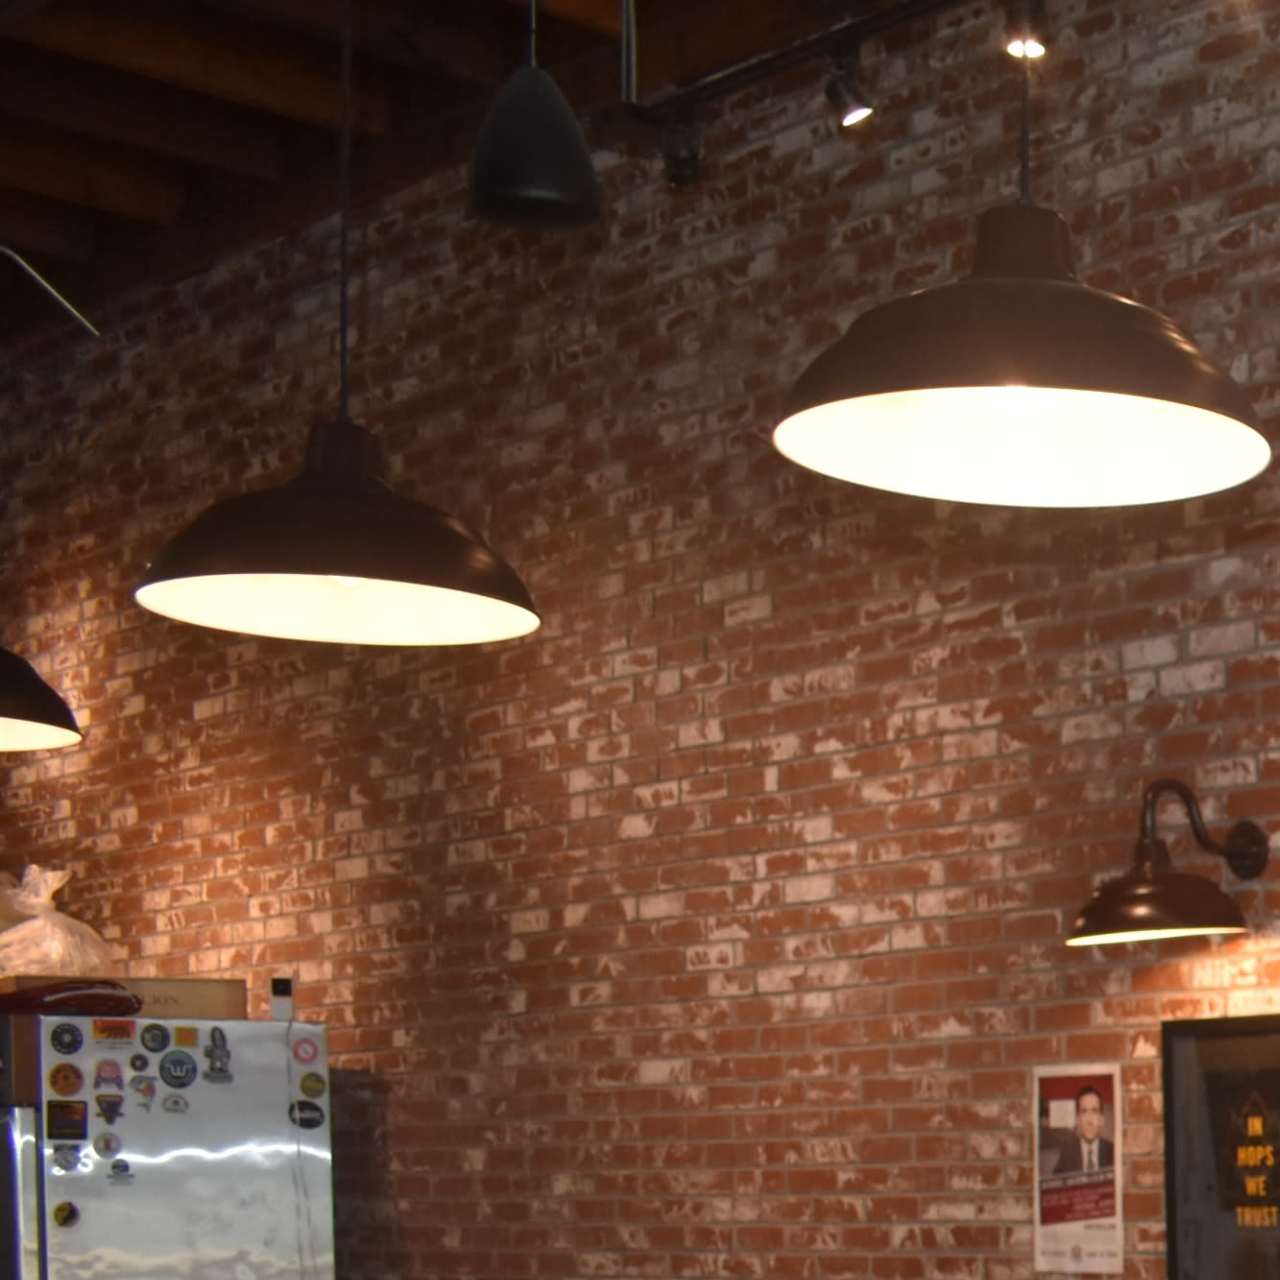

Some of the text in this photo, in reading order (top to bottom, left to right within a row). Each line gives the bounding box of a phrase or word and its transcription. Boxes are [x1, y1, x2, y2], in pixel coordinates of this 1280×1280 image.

[1247, 1116, 1264, 1137] IN
[1237, 1146, 1275, 1168] HOPS
[1245, 1176, 1267, 1197] WE
[1236, 1206, 1279, 1228] TRUST
